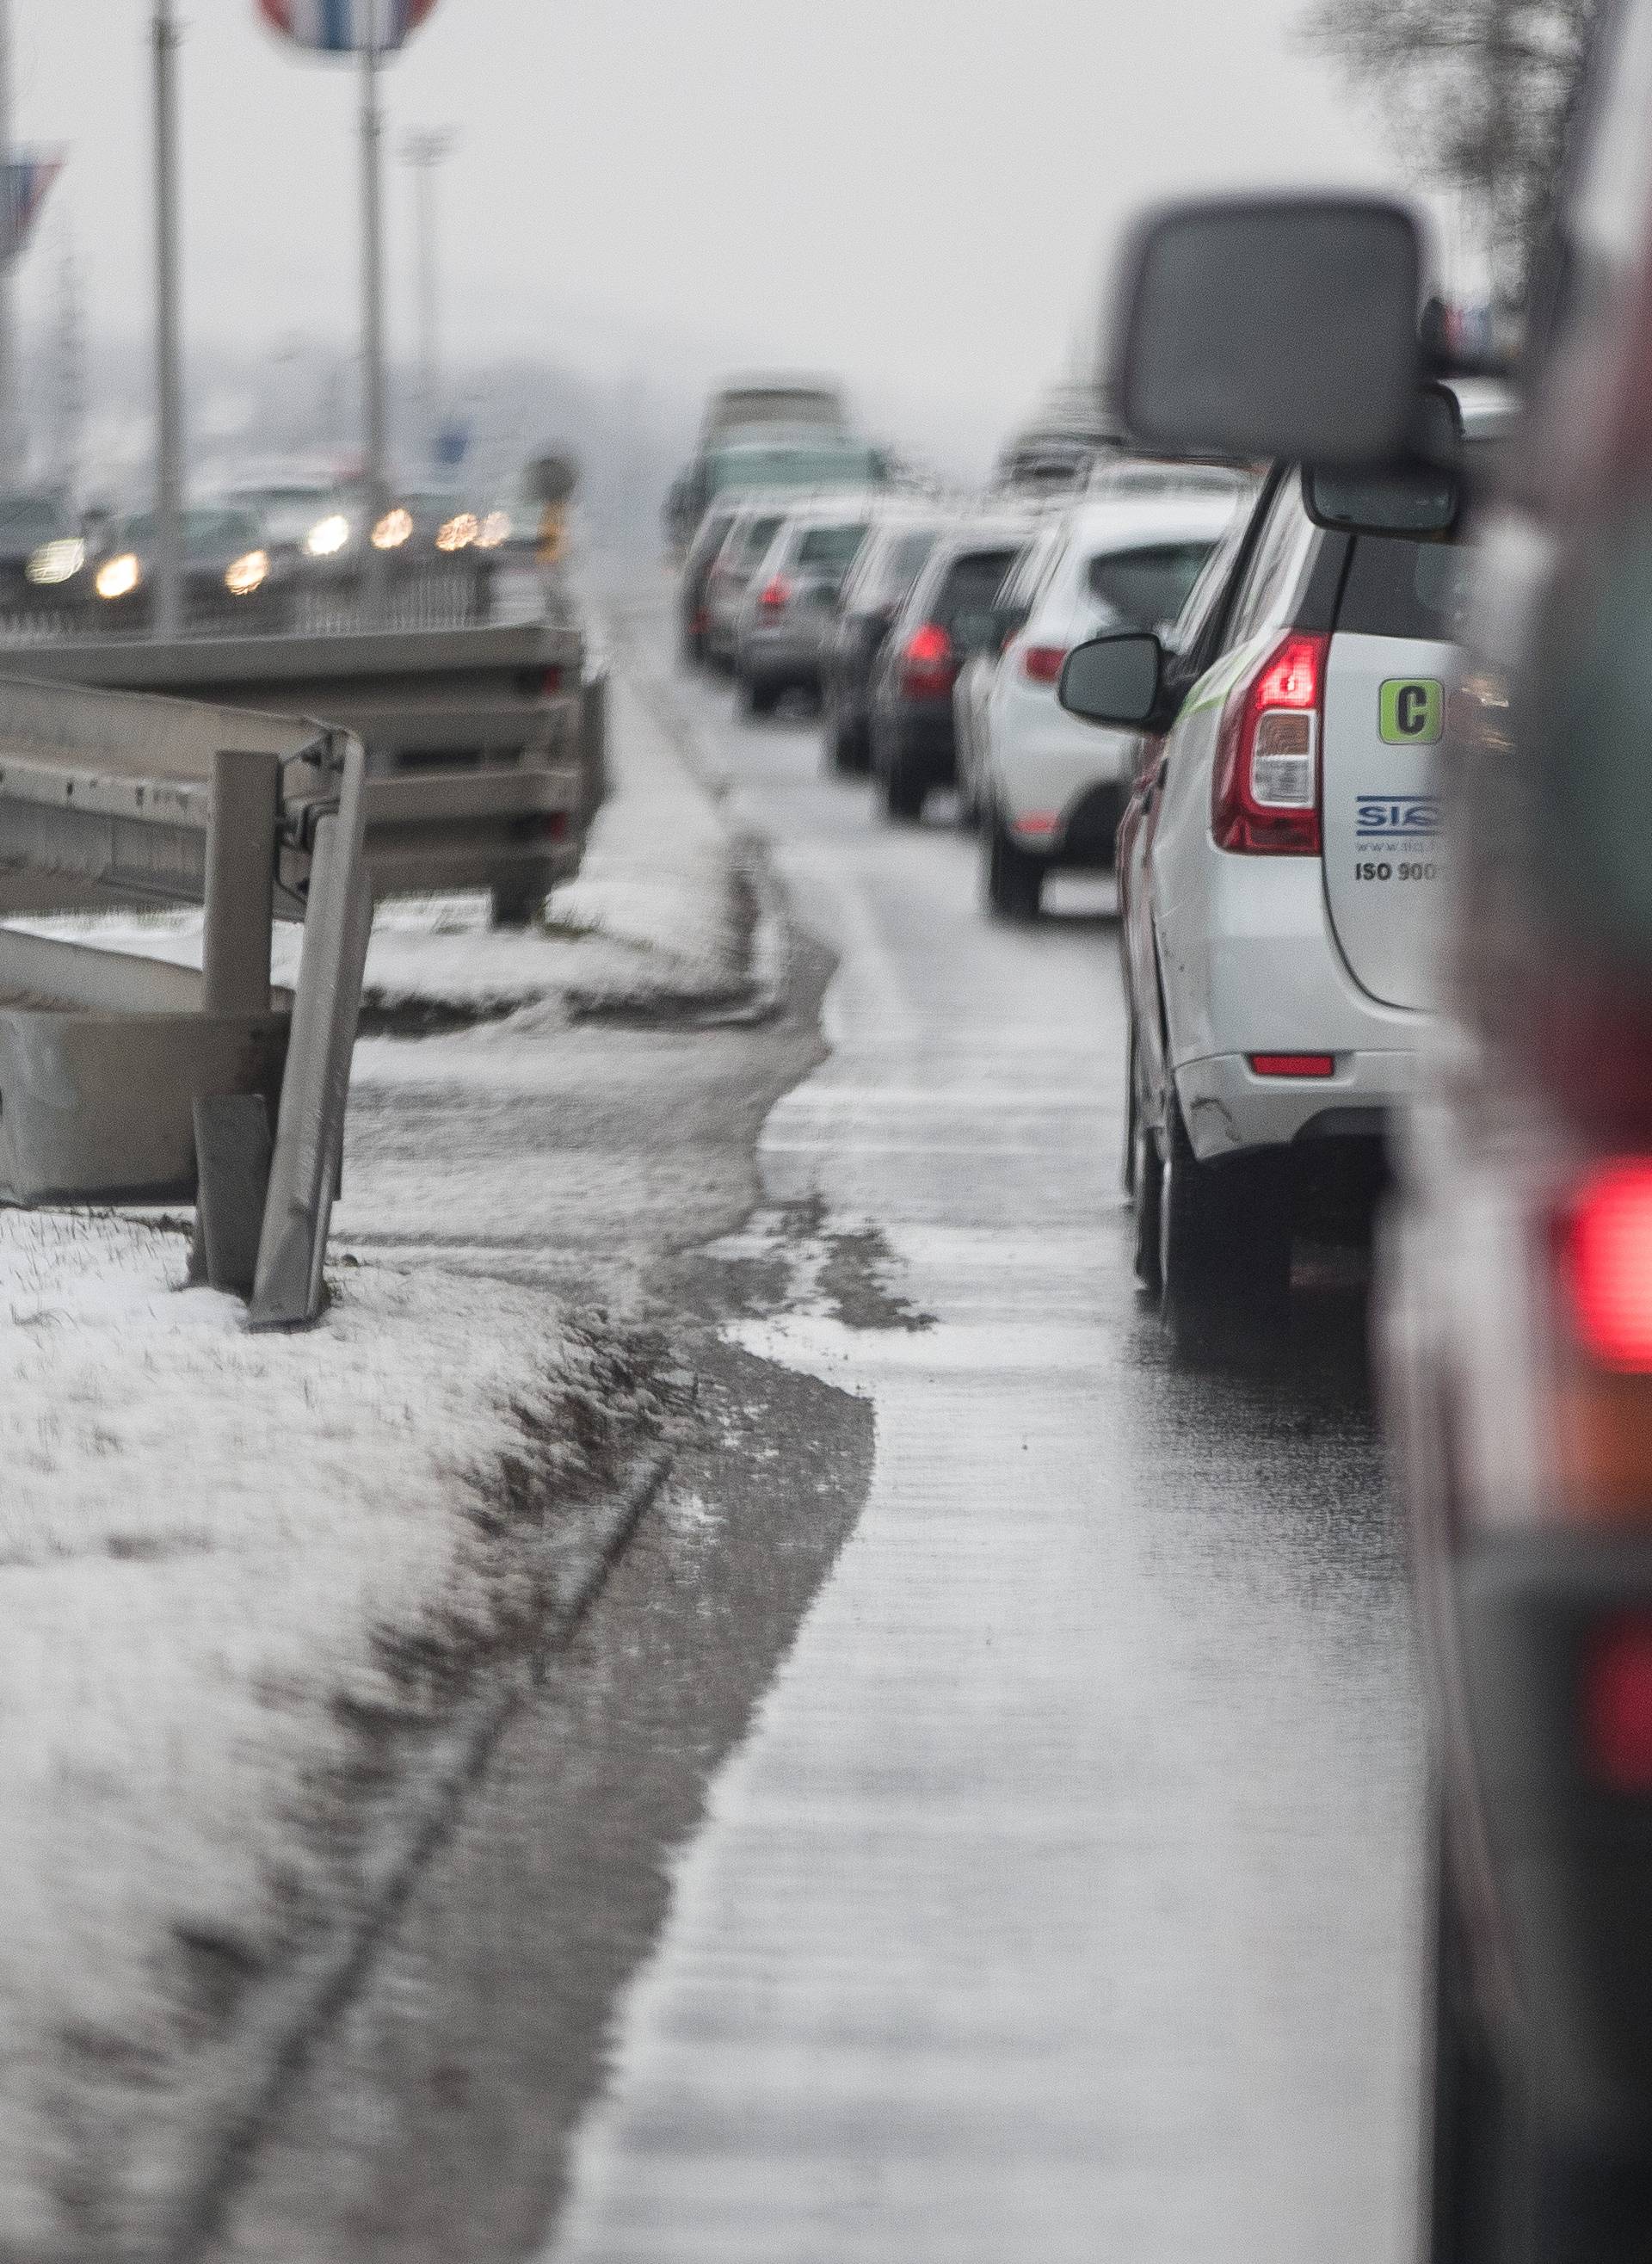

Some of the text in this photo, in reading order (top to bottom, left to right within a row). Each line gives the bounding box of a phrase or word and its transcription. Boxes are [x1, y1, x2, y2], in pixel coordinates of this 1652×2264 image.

[1398, 685, 1427, 734] C
[1355, 862, 1437, 881] ISO 900
